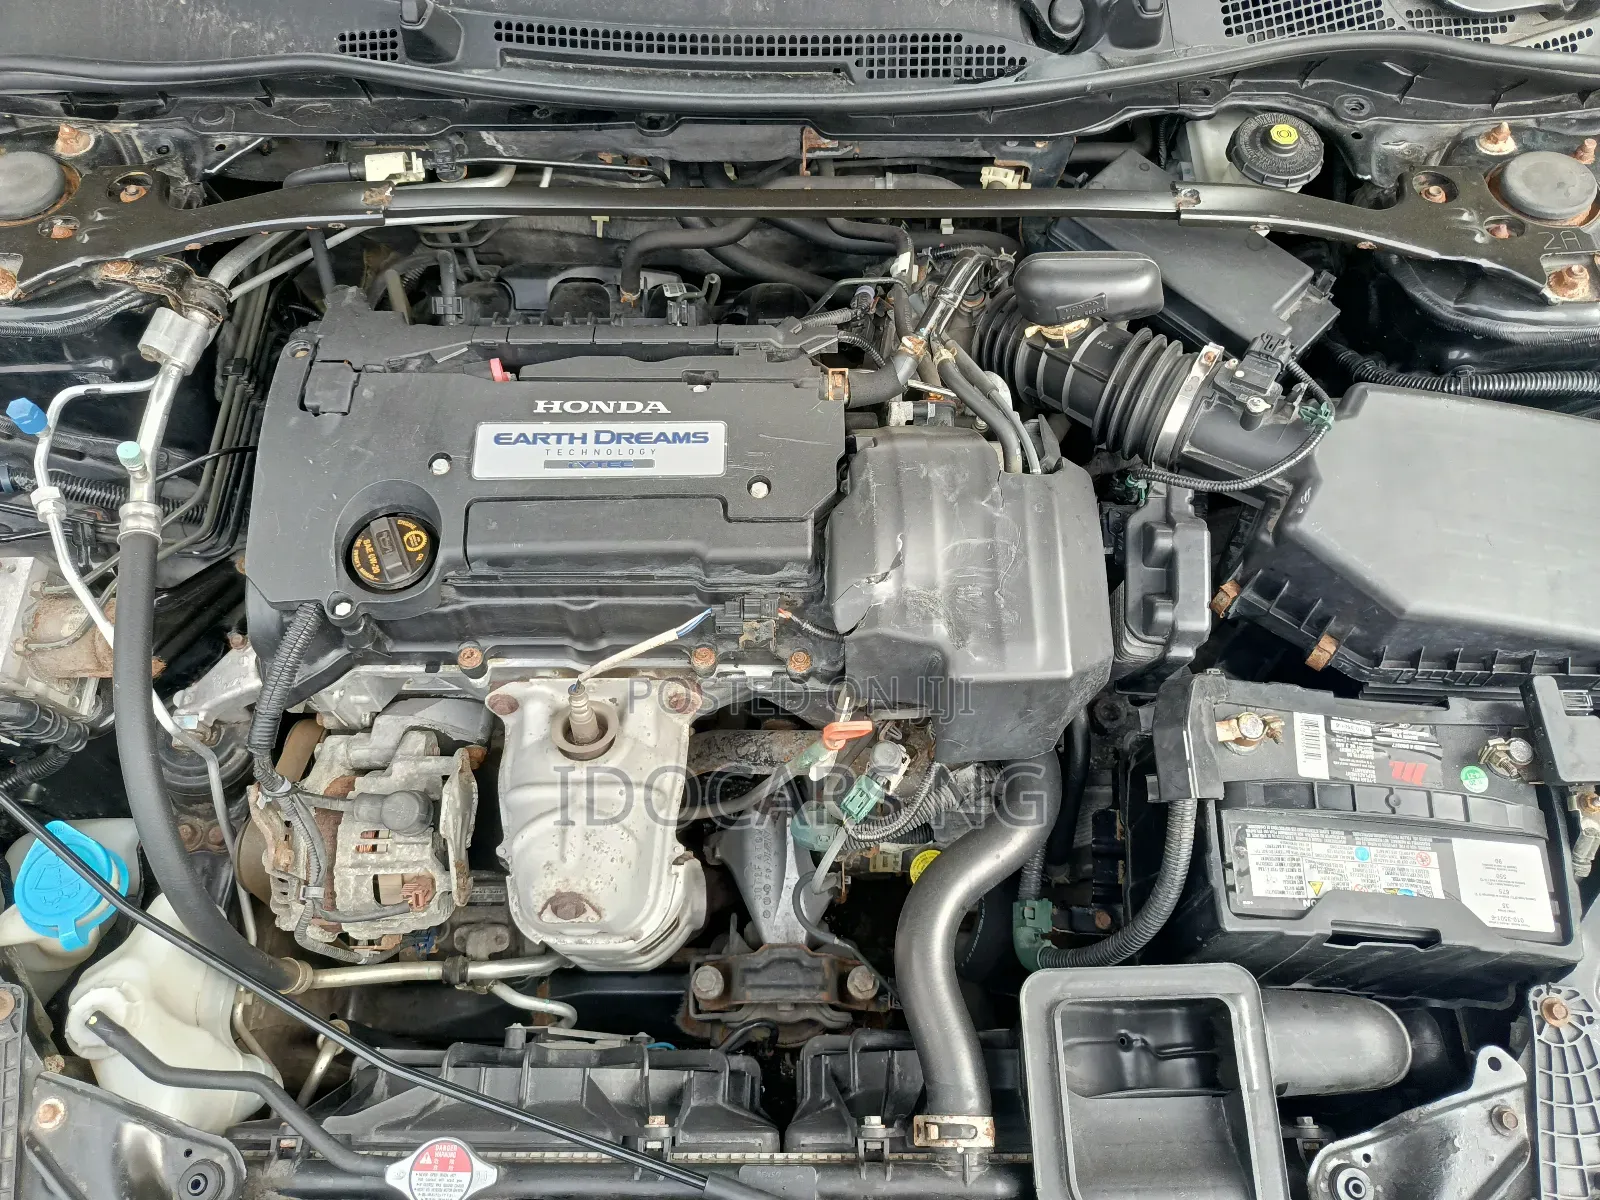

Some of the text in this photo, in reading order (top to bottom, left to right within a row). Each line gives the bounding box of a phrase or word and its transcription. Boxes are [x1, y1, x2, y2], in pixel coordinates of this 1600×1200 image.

[1538, 230, 1582, 250] 2A
[533, 400, 671, 414] HONDA
[494, 430, 710, 445] EARTH DREAMS
[363, 538, 380, 574] SAE 0W-20
[434, 1151, 456, 1159] WARNING
